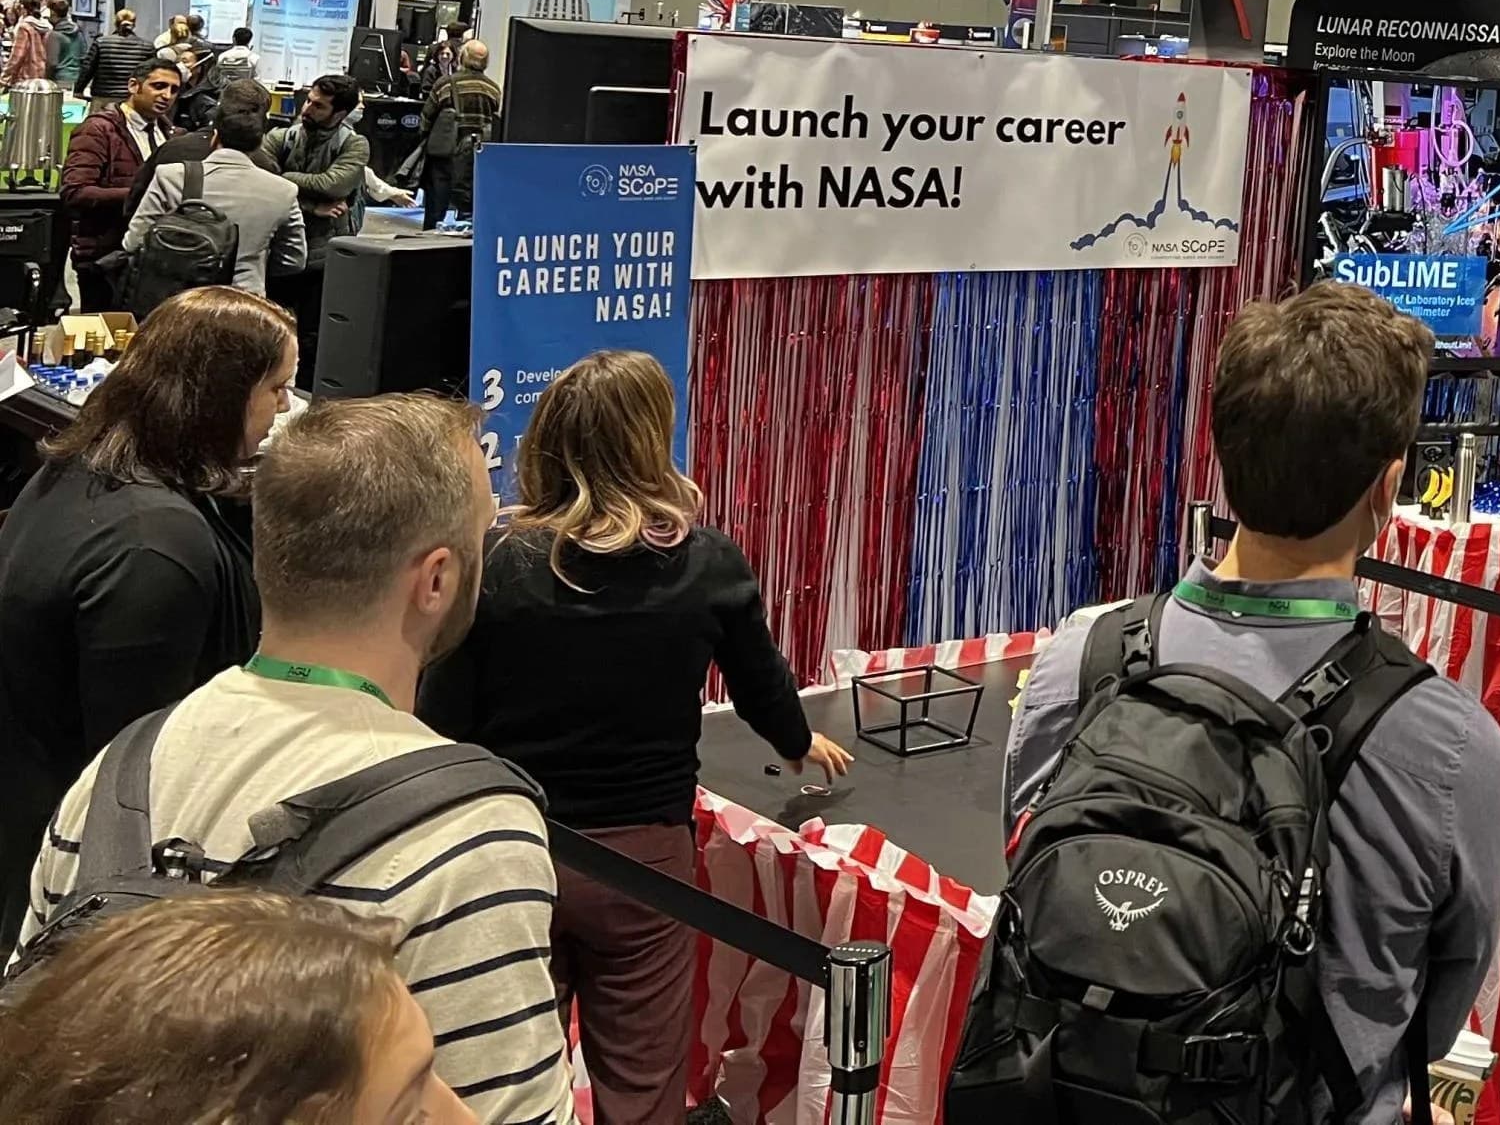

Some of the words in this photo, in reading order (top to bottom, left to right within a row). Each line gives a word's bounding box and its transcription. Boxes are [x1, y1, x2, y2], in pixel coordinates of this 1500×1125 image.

[1317, 15, 1373, 36] LUNAR
[1315, 42, 1357, 60] Explore
[1360, 46, 1378, 61] the
[1381, 48, 1415, 62] Moon
[700, 91, 868, 139] Launch
[882, 109, 986, 151] your
[996, 116, 1126, 146] career
[619, 165, 655, 176] NASA
[618, 178, 678, 195] SCoPE
[696, 165, 802, 209] with
[818, 166, 963, 208] NASA!
[496, 234, 599, 264] LAUNCH
[613, 231, 675, 259] YOUR
[1152, 243, 1178, 253] NASA
[498, 266, 600, 296] CAREER
[614, 262, 673, 290] WITH
[1336, 259, 1458, 289] SubLIME
[596, 292, 671, 323] NASA!
[1393, 294, 1404, 305] of
[1406, 294, 1454, 307] Laboratory
[1457, 295, 1475, 306] Ices
[482, 369, 504, 411] 3
[516, 368, 566, 384] Develo
[480, 432, 501, 470] 2
[288, 666, 311, 677] AGU
[1099, 869, 1169, 898] OSPREY
